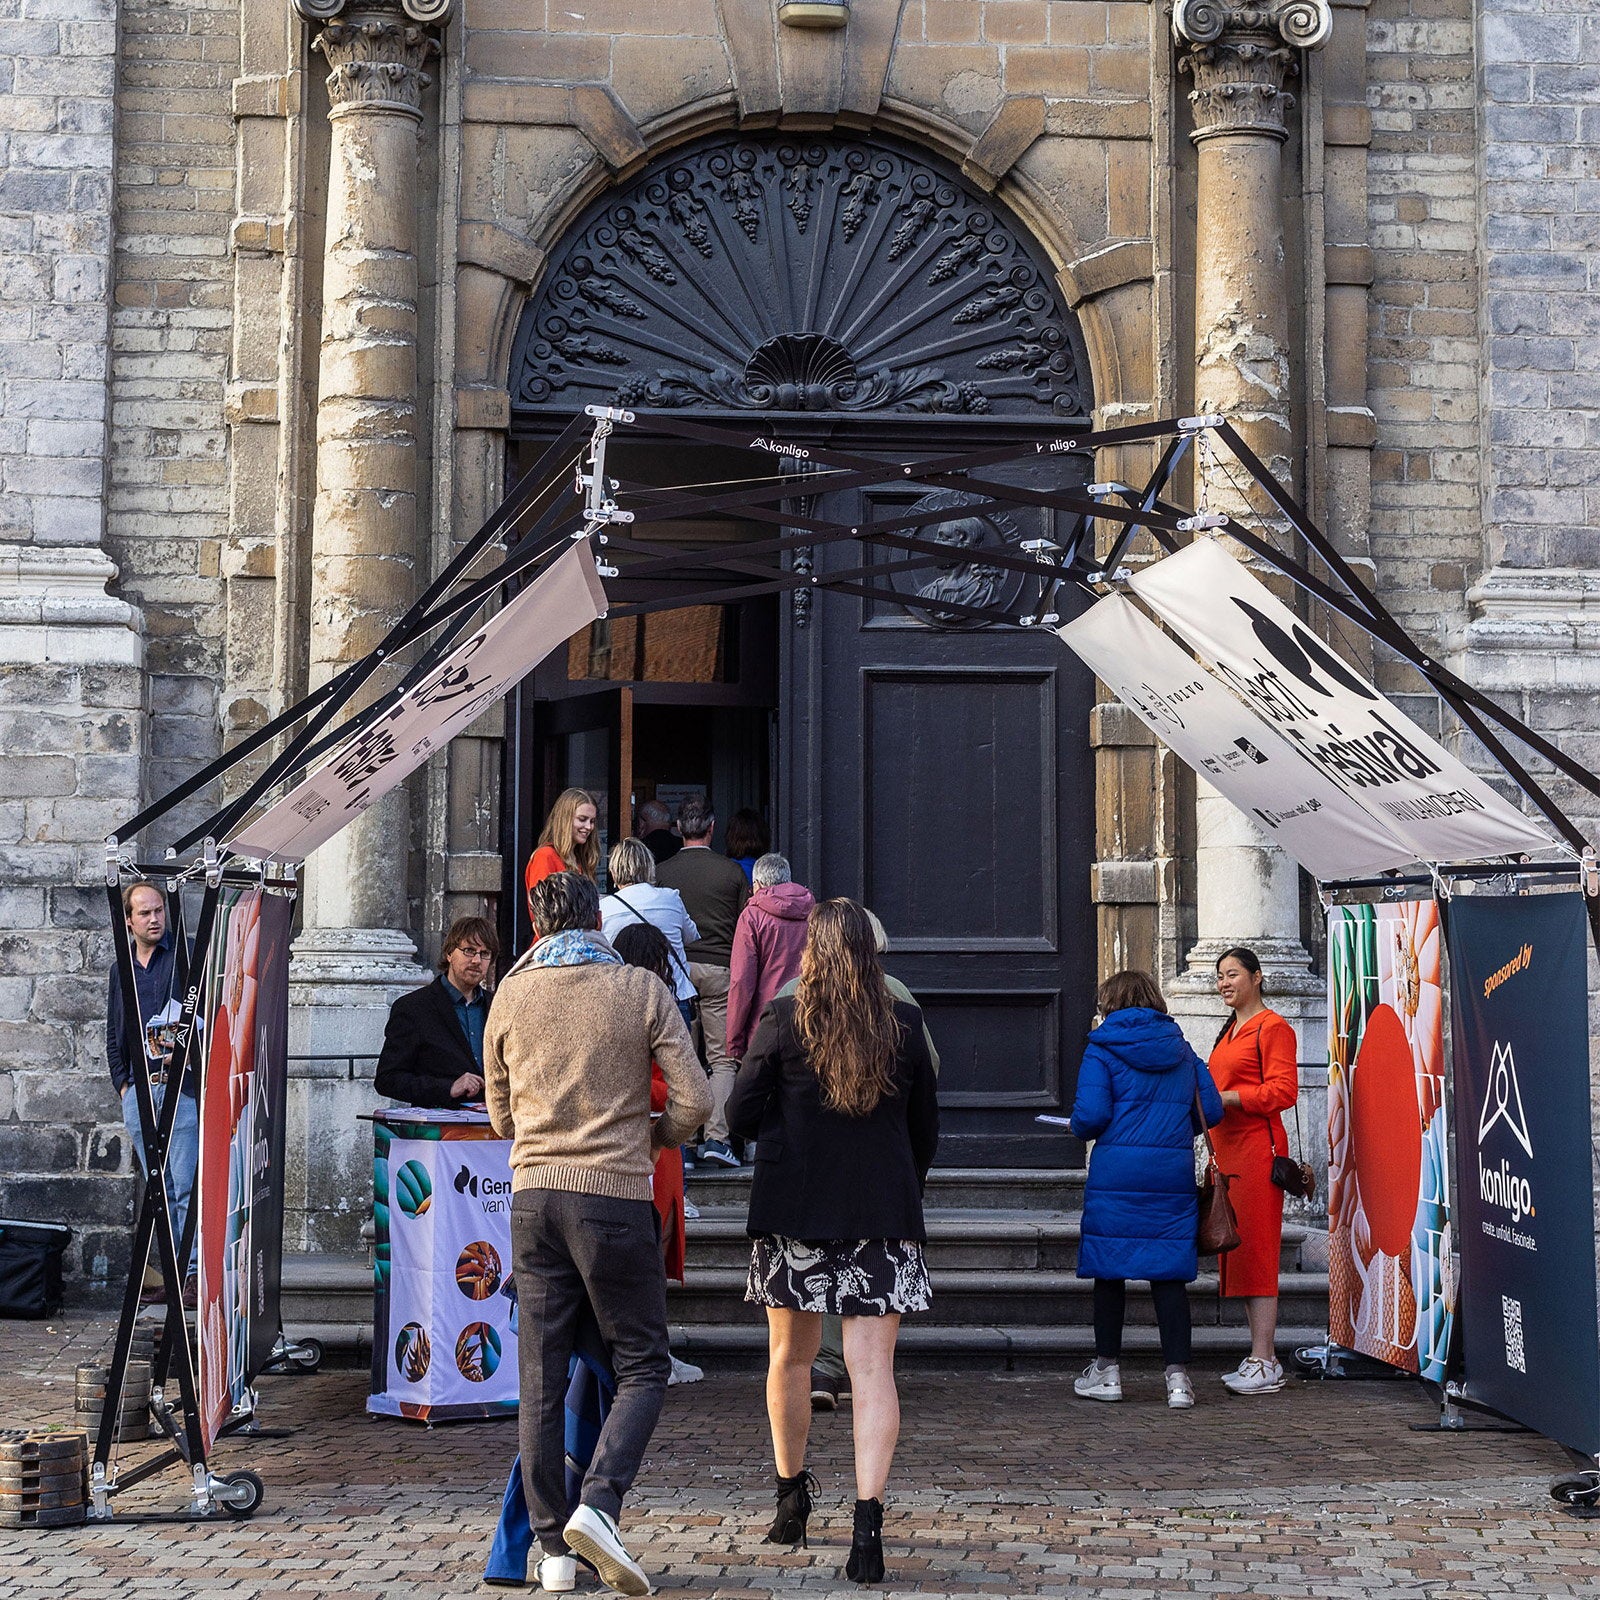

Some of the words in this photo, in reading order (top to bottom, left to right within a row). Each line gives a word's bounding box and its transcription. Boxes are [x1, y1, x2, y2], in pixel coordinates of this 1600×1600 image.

[770, 440, 809, 458] konligo
[1167, 681, 1204, 705] VOLVO
[1286, 710, 1443, 788] Festival
[1484, 946, 1523, 999] sponsored
[1522, 943, 1533, 970] by
[482, 1178, 512, 1195] Gen
[482, 1200, 504, 1213] van
